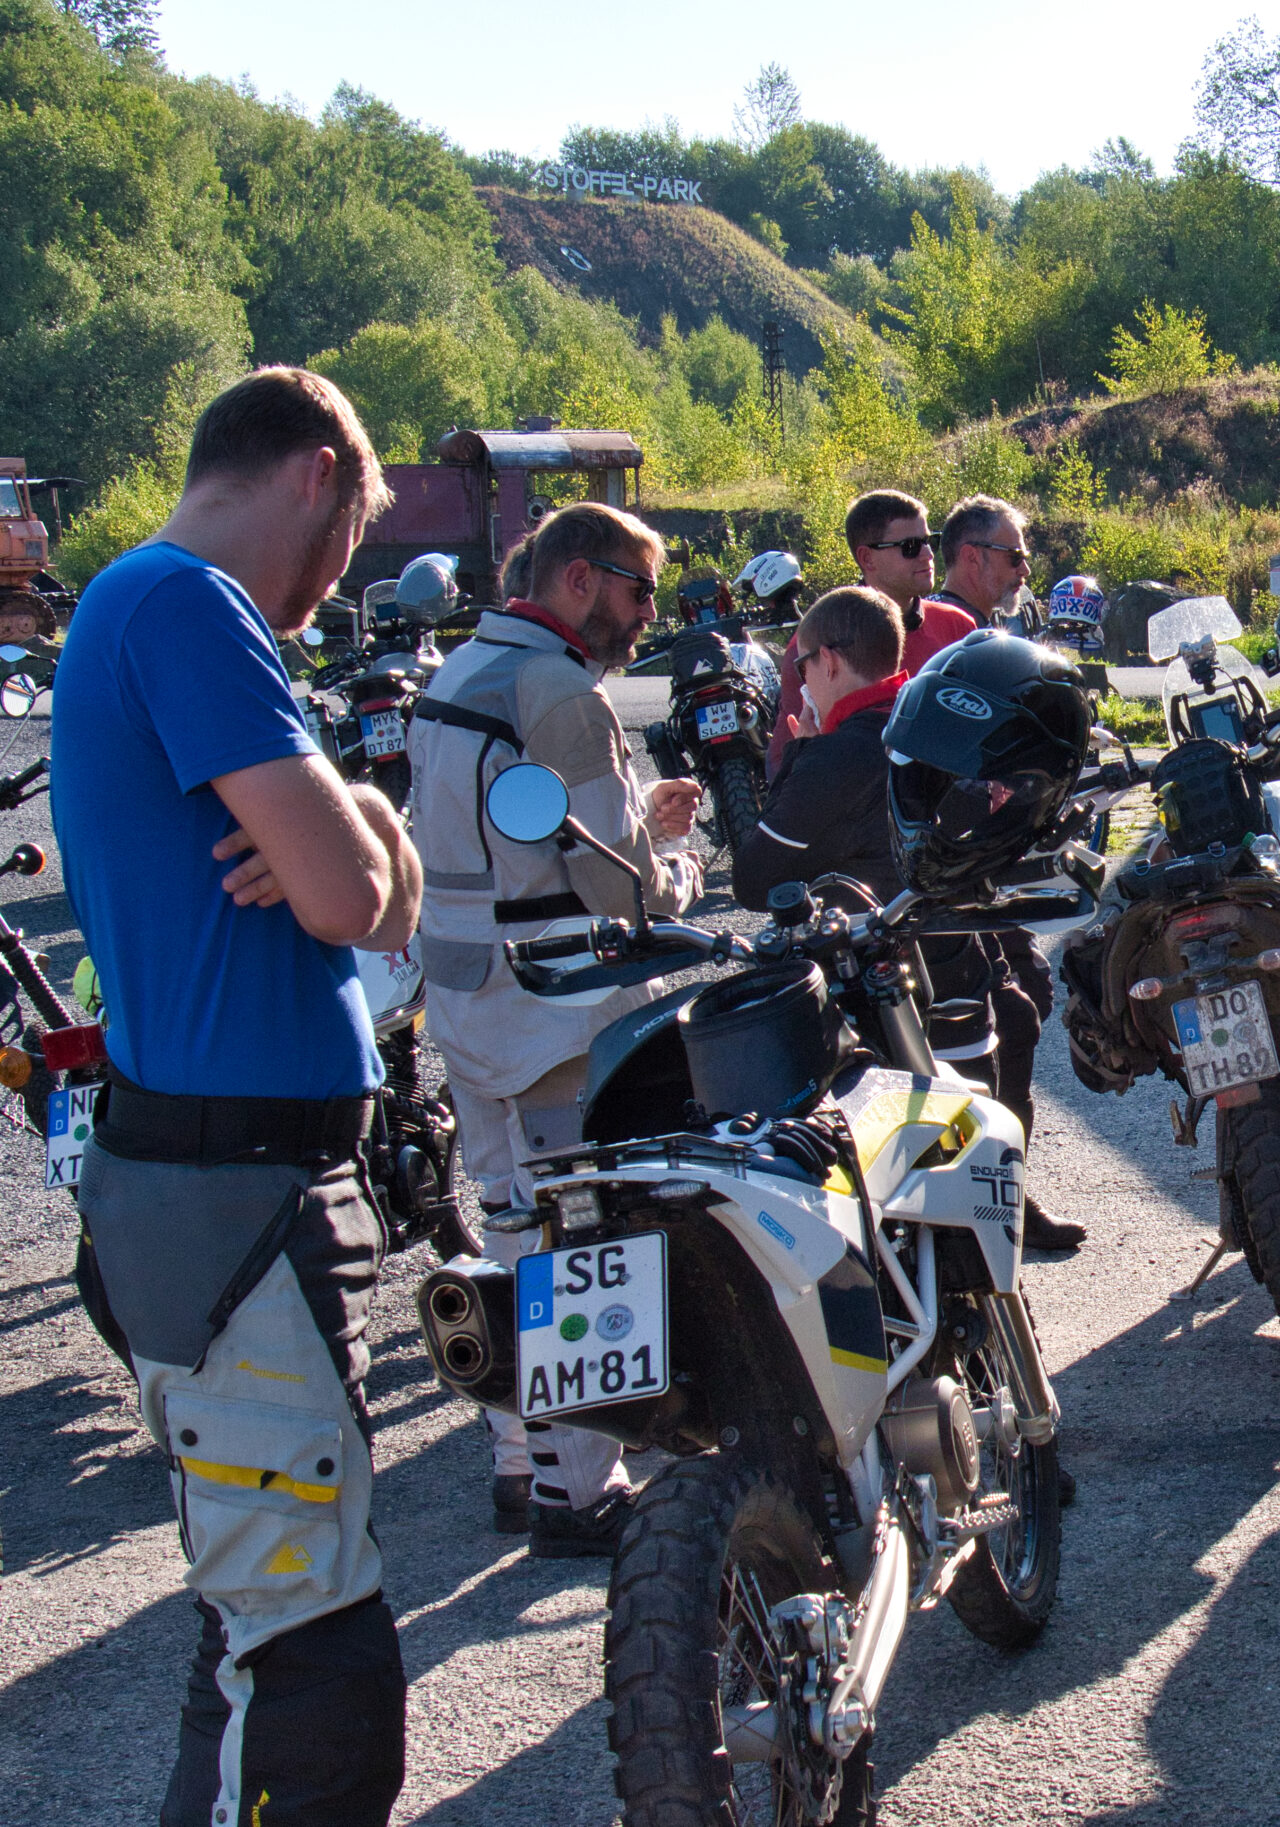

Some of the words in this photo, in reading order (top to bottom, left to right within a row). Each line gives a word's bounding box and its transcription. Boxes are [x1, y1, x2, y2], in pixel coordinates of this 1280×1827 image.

[711, 704, 727, 715] WW
[941, 691, 987, 715] Arai
[372, 711, 398, 727] MYK
[702, 727, 714, 737] SL
[720, 722, 736, 732] 69
[368, 742, 384, 756] DT
[386, 737, 402, 751] 87
[1208, 990, 1248, 1021] DO
[1192, 1057, 1232, 1089] TH
[1236, 1047, 1271, 1078] 89
[55, 1120, 64, 1131] D
[969, 1165, 1009, 1178] ENDURO
[565, 1245, 627, 1295] SG
[529, 1301, 544, 1320] D
[526, 1356, 585, 1412] AM
[599, 1344, 658, 1394] 81
